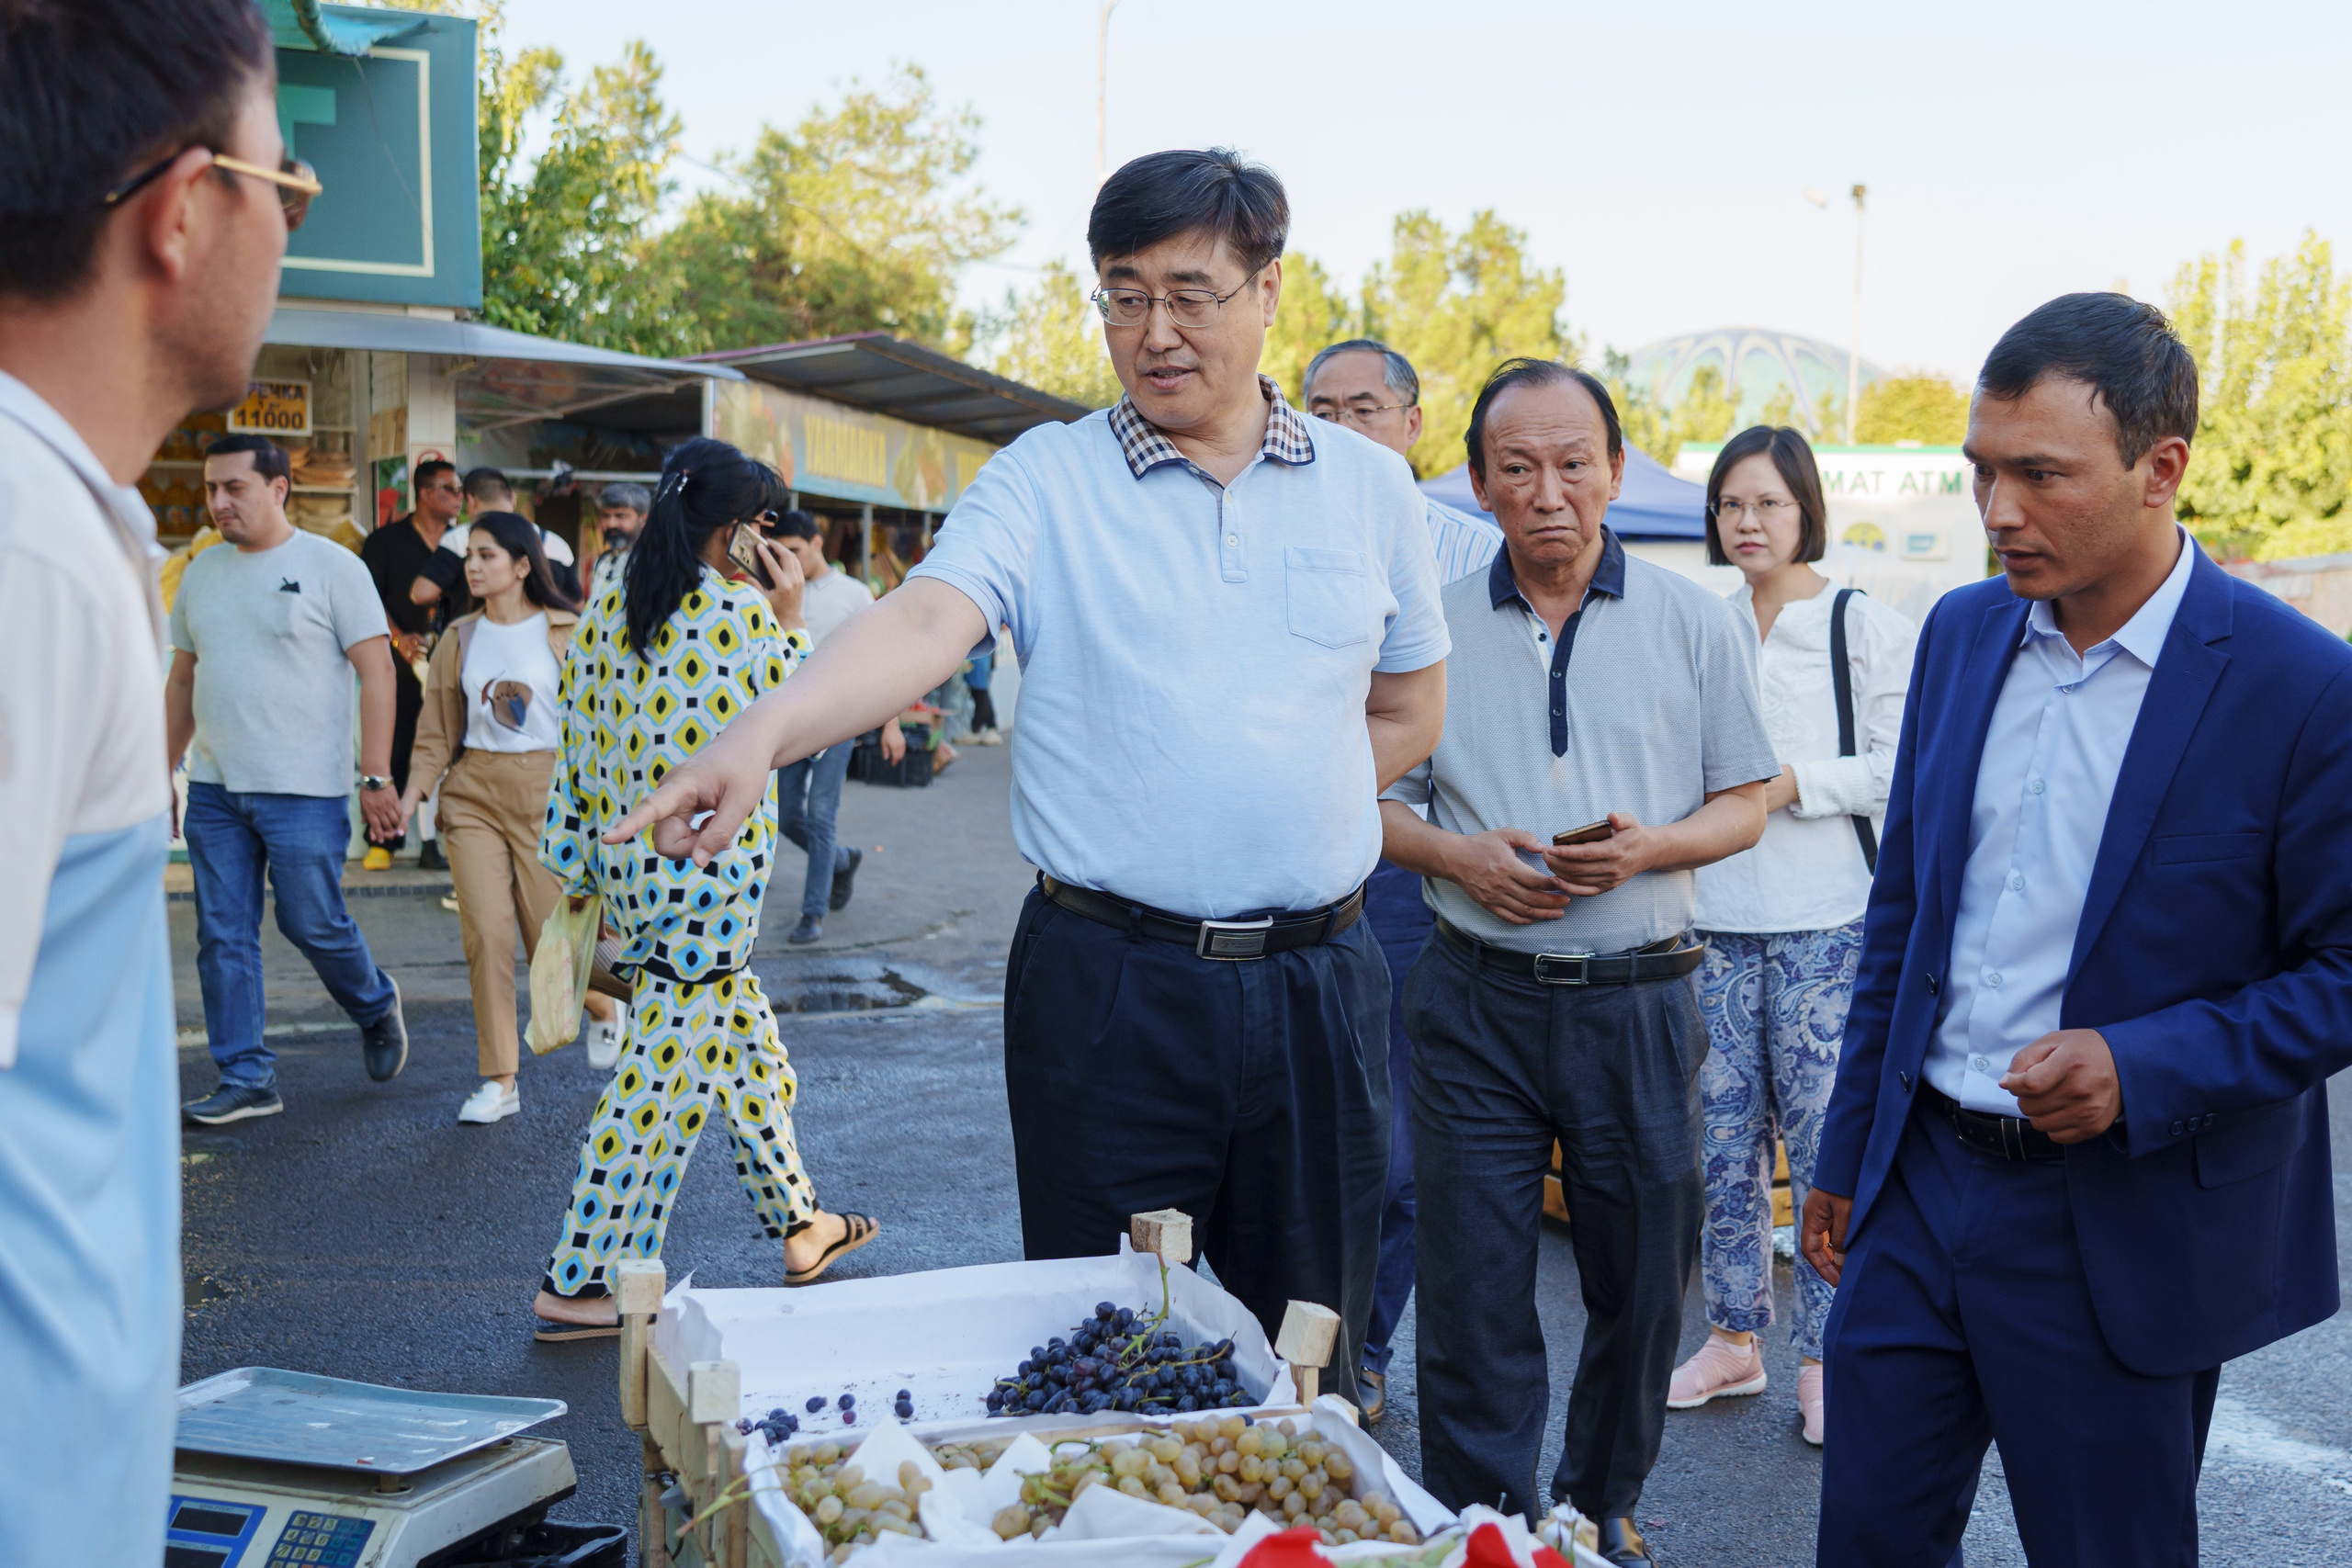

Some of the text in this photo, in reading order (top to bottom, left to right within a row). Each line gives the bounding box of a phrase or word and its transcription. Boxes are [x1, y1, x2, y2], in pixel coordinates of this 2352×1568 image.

[247, 382, 305, 400] РЕЧКА
[238, 410, 303, 428] 11000
[805, 413, 886, 488] YARMARKA
[1823, 469, 1963, 495] MAT ATM
